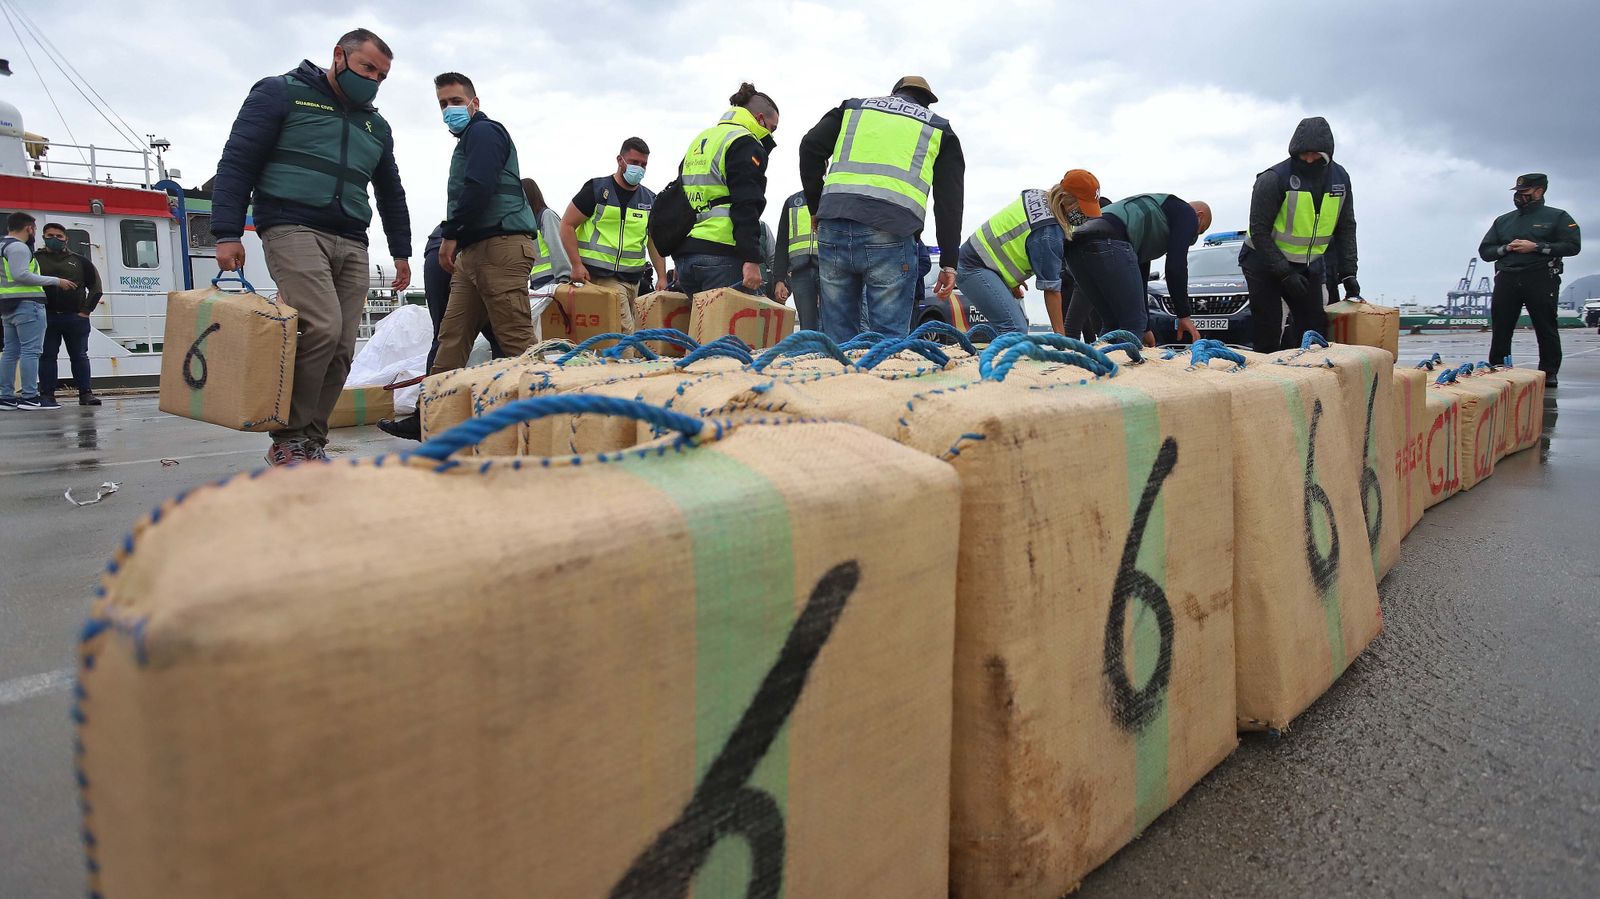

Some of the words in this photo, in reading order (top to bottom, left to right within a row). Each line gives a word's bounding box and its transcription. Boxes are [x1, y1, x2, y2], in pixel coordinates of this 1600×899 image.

[295, 100, 321, 108] GUARDIA
[320, 104, 335, 112] CIVIL
[864, 99, 928, 120] POLICIA
[119, 276, 161, 286] KNOX
[182, 322, 221, 391] 6
[1304, 397, 1341, 602] 6
[1359, 371, 1383, 556] 6
[1103, 435, 1179, 732] 6
[607, 559, 861, 899] 6
